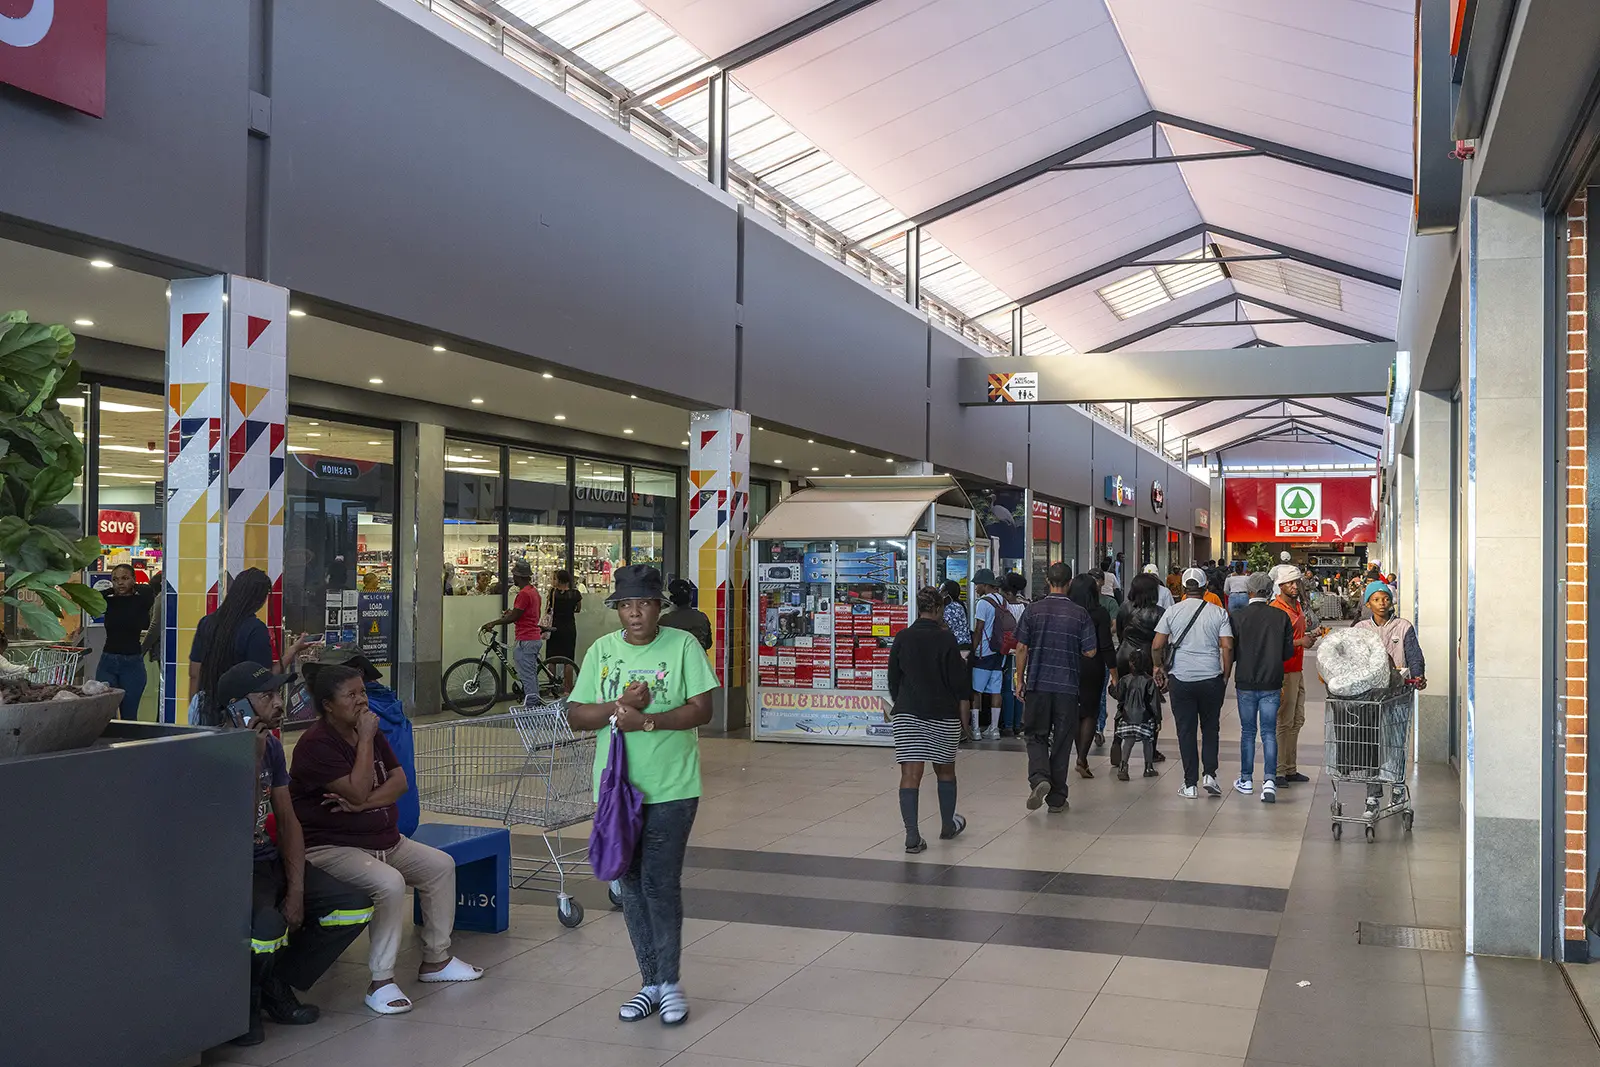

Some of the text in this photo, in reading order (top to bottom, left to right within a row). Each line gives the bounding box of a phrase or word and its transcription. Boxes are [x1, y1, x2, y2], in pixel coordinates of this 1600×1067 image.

[100, 520, 135, 534] save
[763, 693, 795, 707] CELL
[797, 693, 808, 708] &
